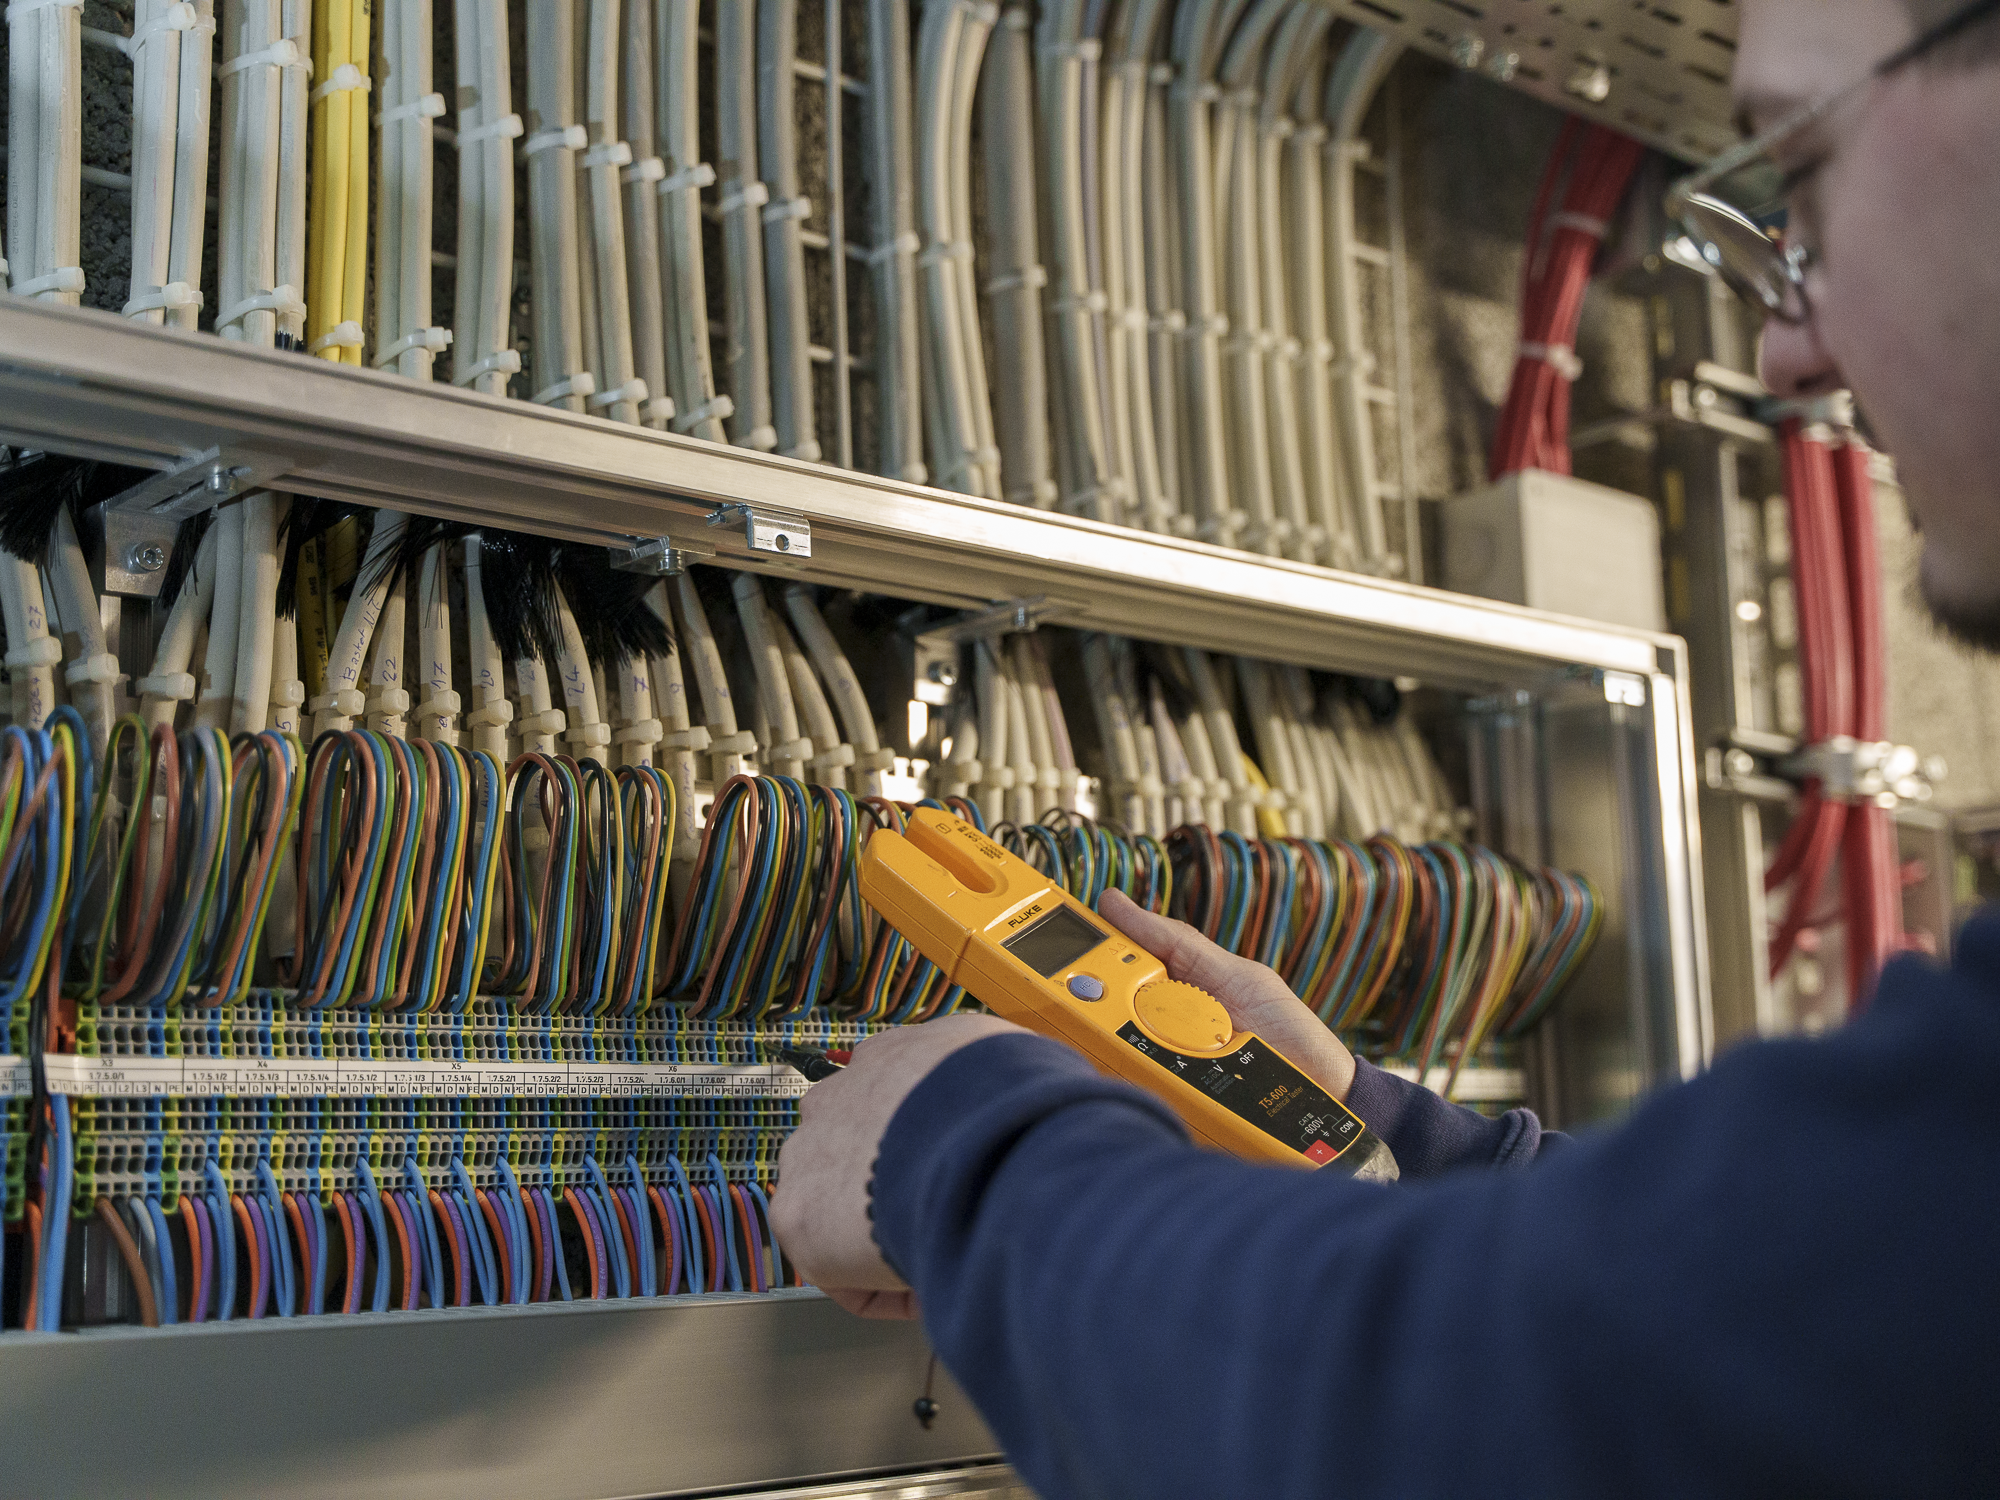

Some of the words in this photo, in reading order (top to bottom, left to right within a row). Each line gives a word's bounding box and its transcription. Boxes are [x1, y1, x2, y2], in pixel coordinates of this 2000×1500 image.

[382, 656, 397, 683] 22
[430, 661, 446, 690] 17
[567, 665, 585, 697] 24
[275, 716, 292, 732] 5
[1007, 905, 1042, 928] FLUKE
[1177, 1060, 1187, 1069] A
[1240, 1051, 1255, 1065] OFF
[1214, 1064, 1224, 1073] V
[85, 1083, 94, 1092] PE
[102, 1083, 111, 1092] L1
[119, 1083, 129, 1092] L2
[136, 1083, 147, 1092] L3
[1258, 1085, 1288, 1109] T5-600
[1266, 1094, 1291, 1118] Electrical
[1287, 1085, 1304, 1100] Tester
[1298, 1116, 1309, 1126] CAT
[1304, 1116, 1324, 1135] 600V
[1339, 1121, 1355, 1134] COM
